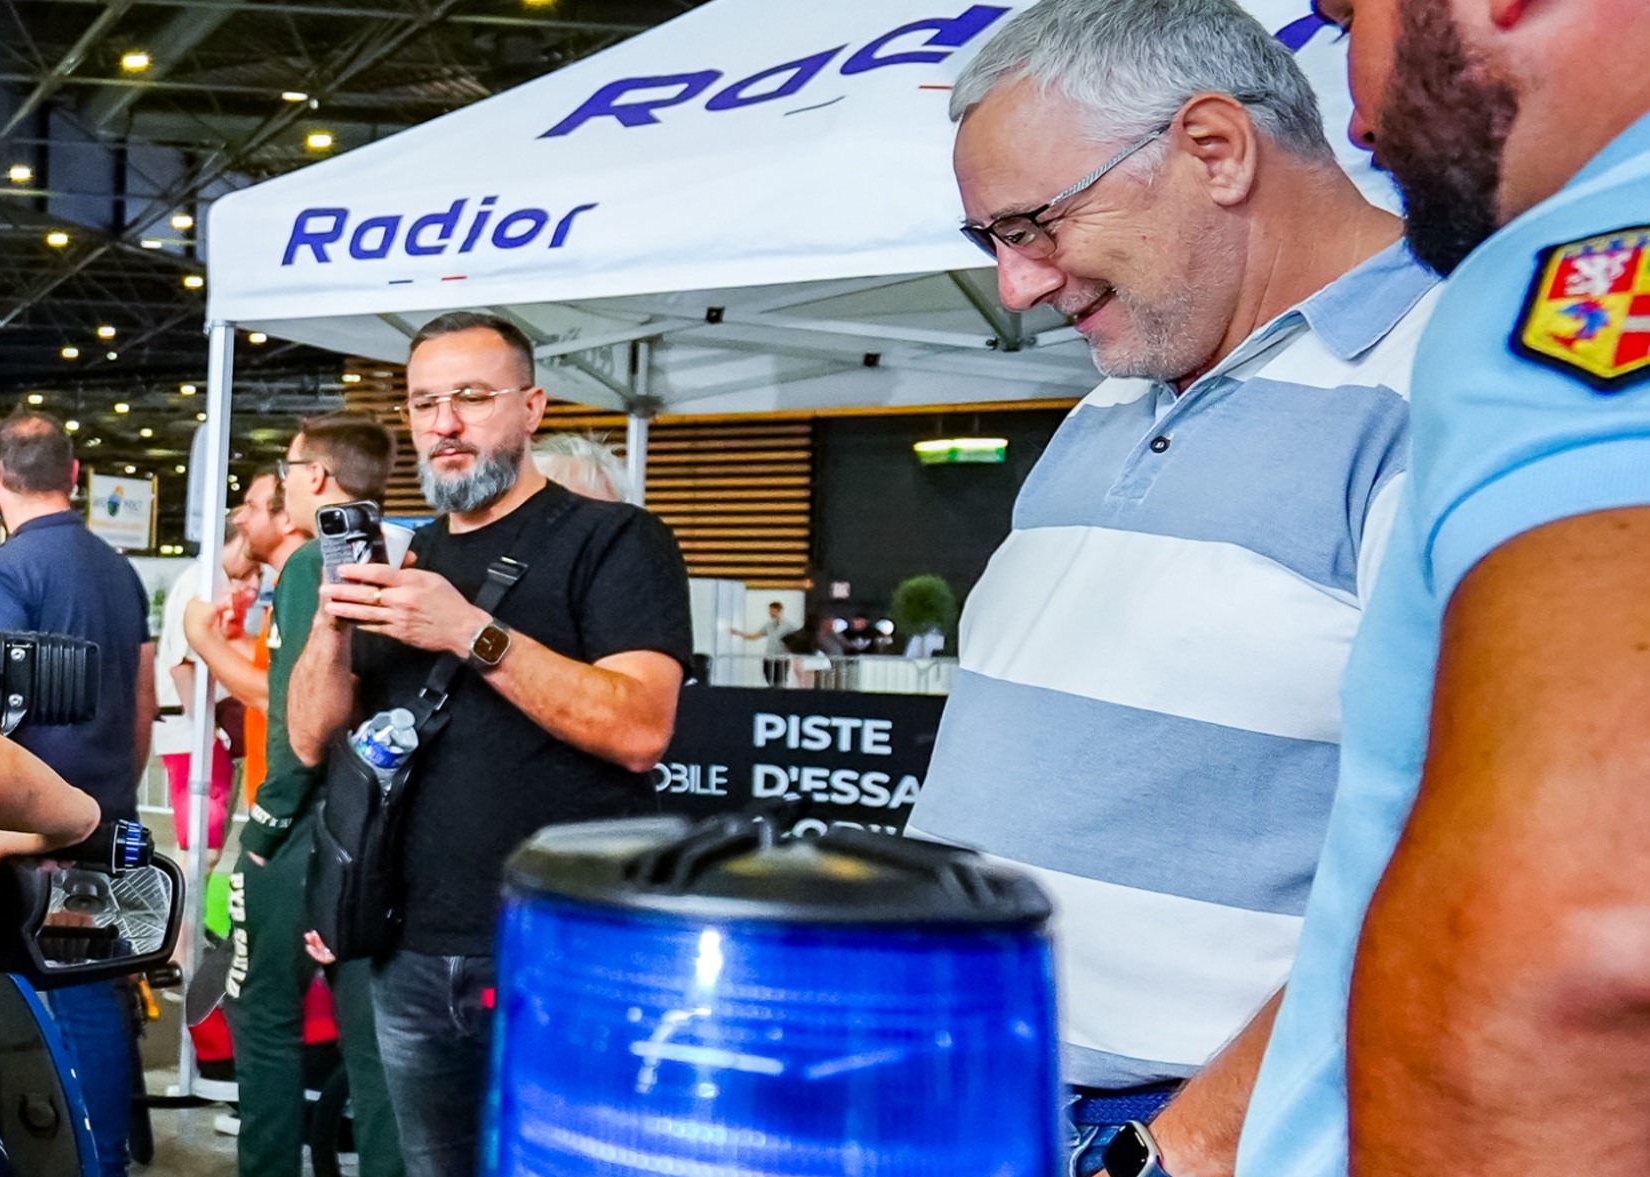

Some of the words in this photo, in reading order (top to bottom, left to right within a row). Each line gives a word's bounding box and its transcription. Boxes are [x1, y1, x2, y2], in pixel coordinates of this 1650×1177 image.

[534, 4, 1016, 140] Rad
[281, 194, 600, 266] Radior
[753, 712, 893, 755] PISTE
